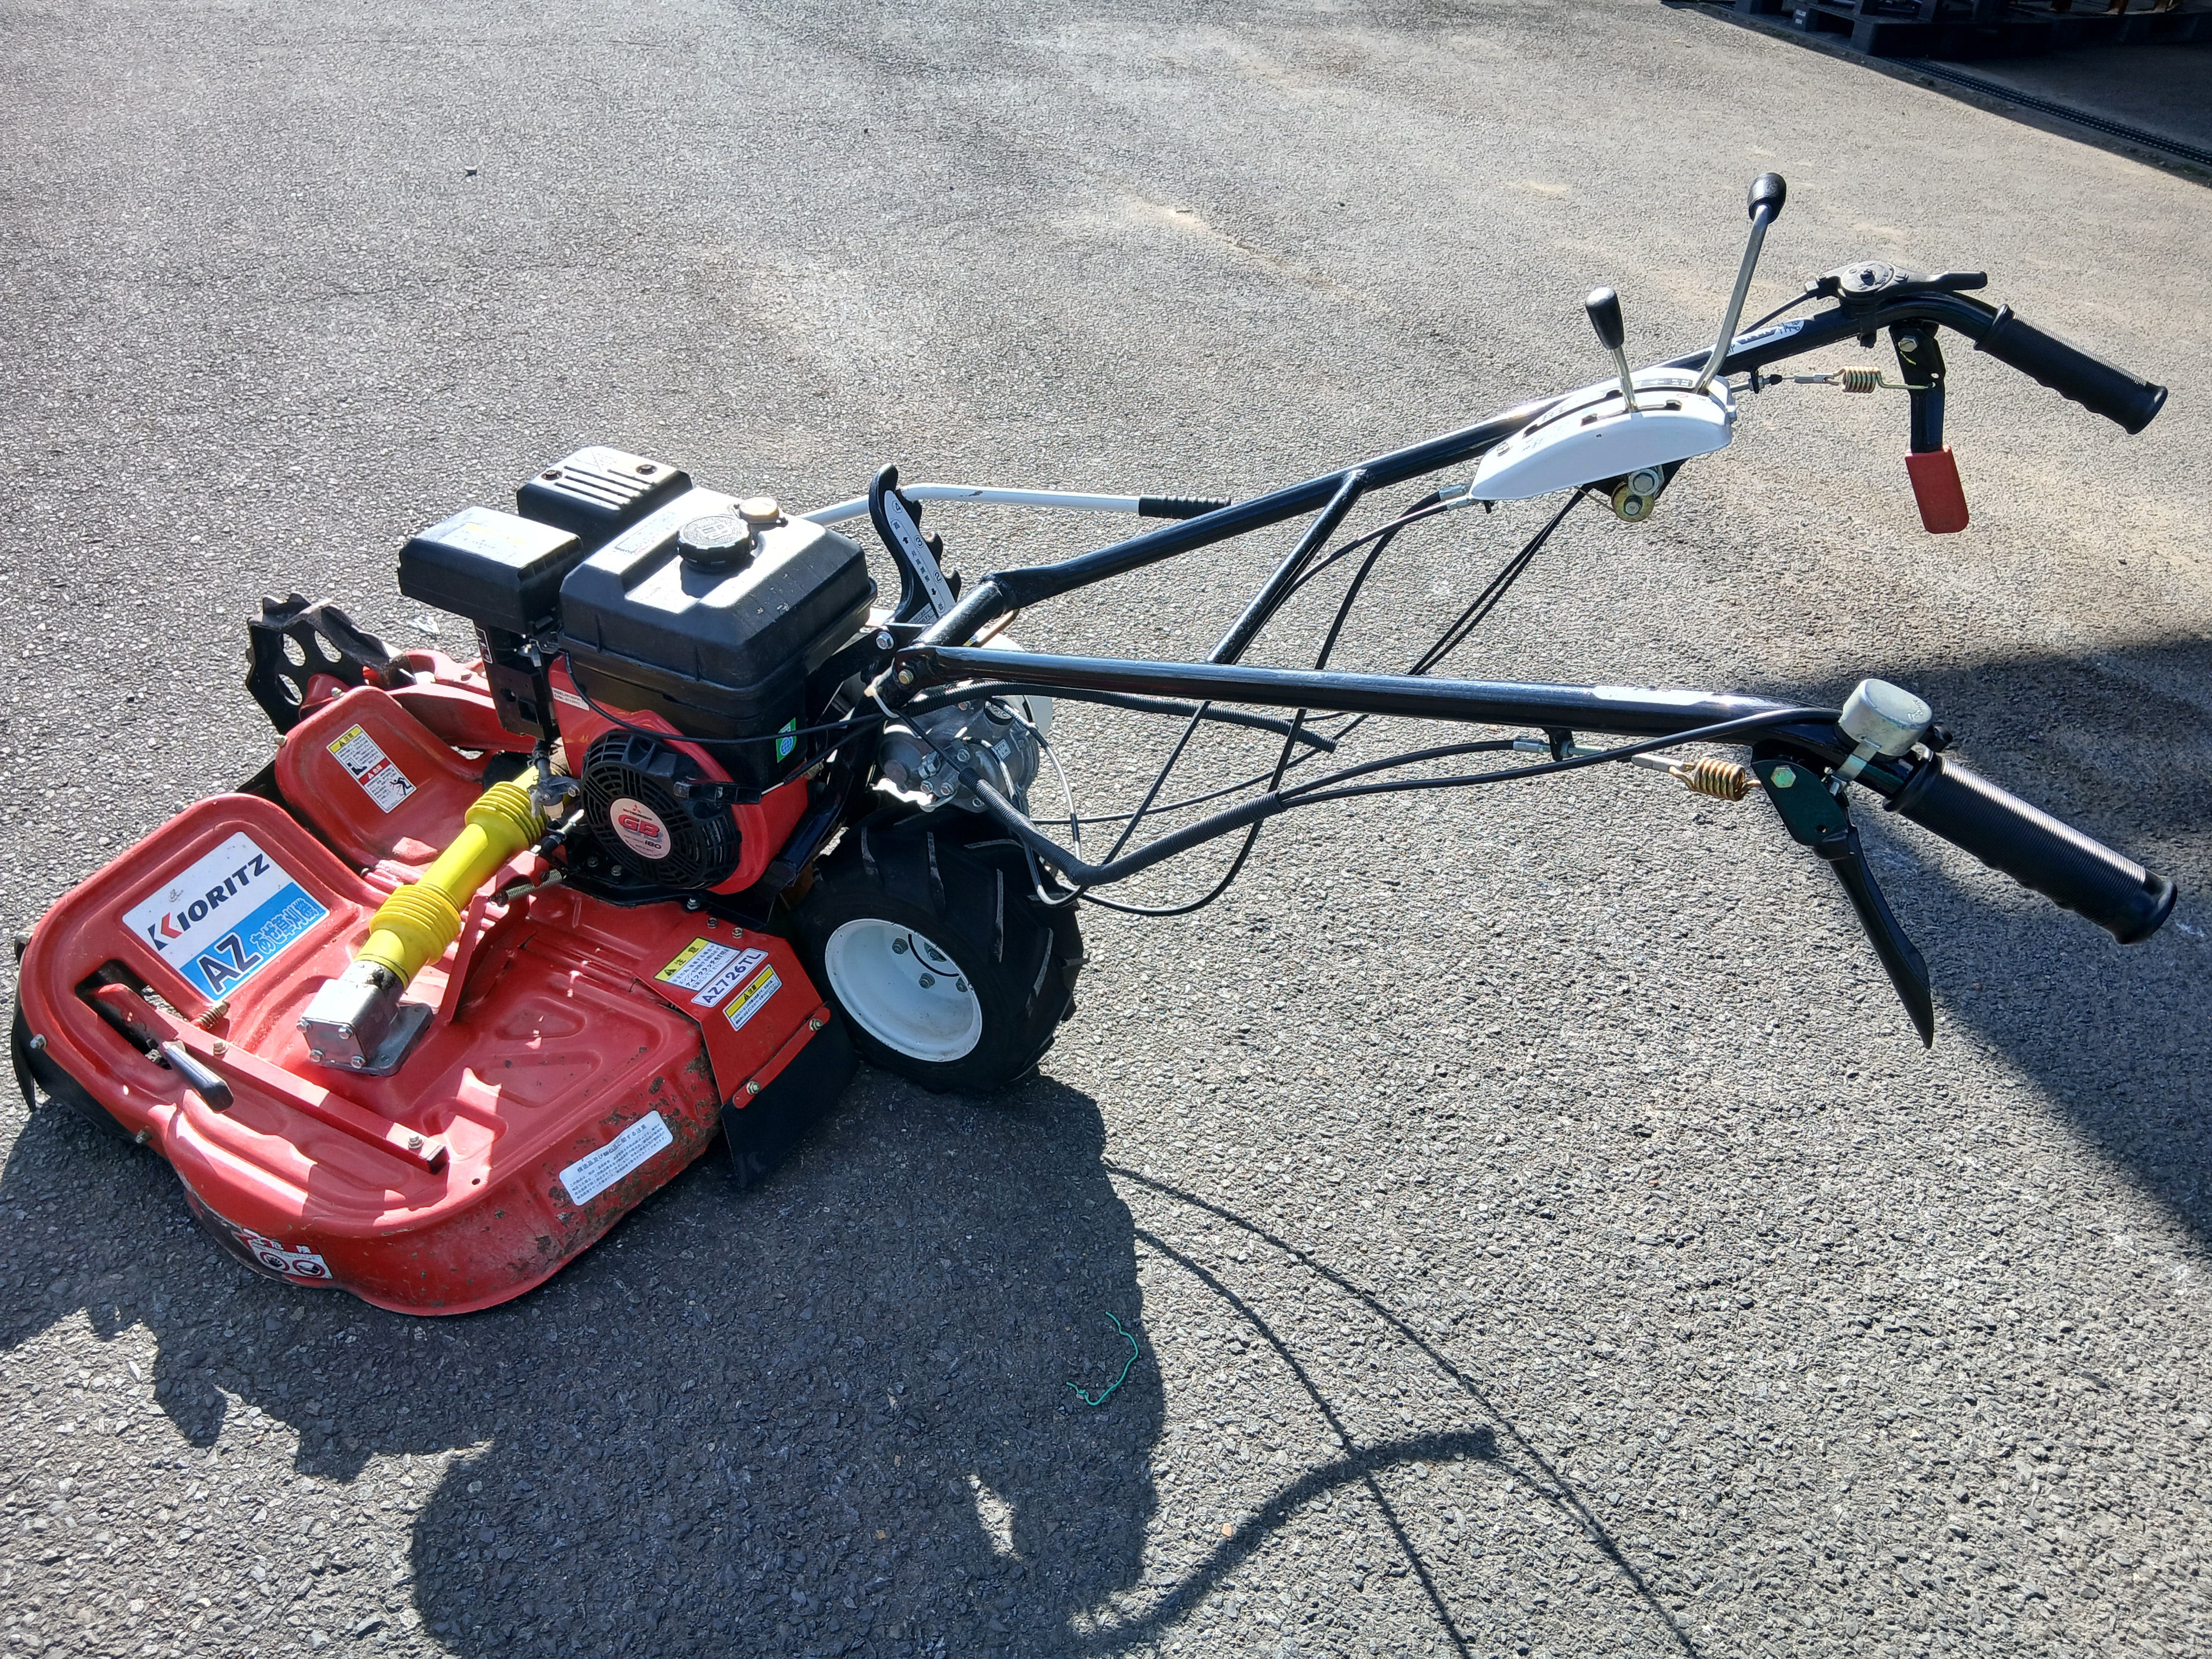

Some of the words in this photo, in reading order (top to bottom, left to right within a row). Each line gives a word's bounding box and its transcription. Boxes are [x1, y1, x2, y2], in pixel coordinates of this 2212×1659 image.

[618, 814, 660, 838] GB
[645, 840, 661, 849] 180
[148, 853, 270, 951] KIORITZ
[197, 933, 263, 994] AZ
[674, 946, 700, 967] 注意
[702, 953, 762, 1004] AZ726TL
